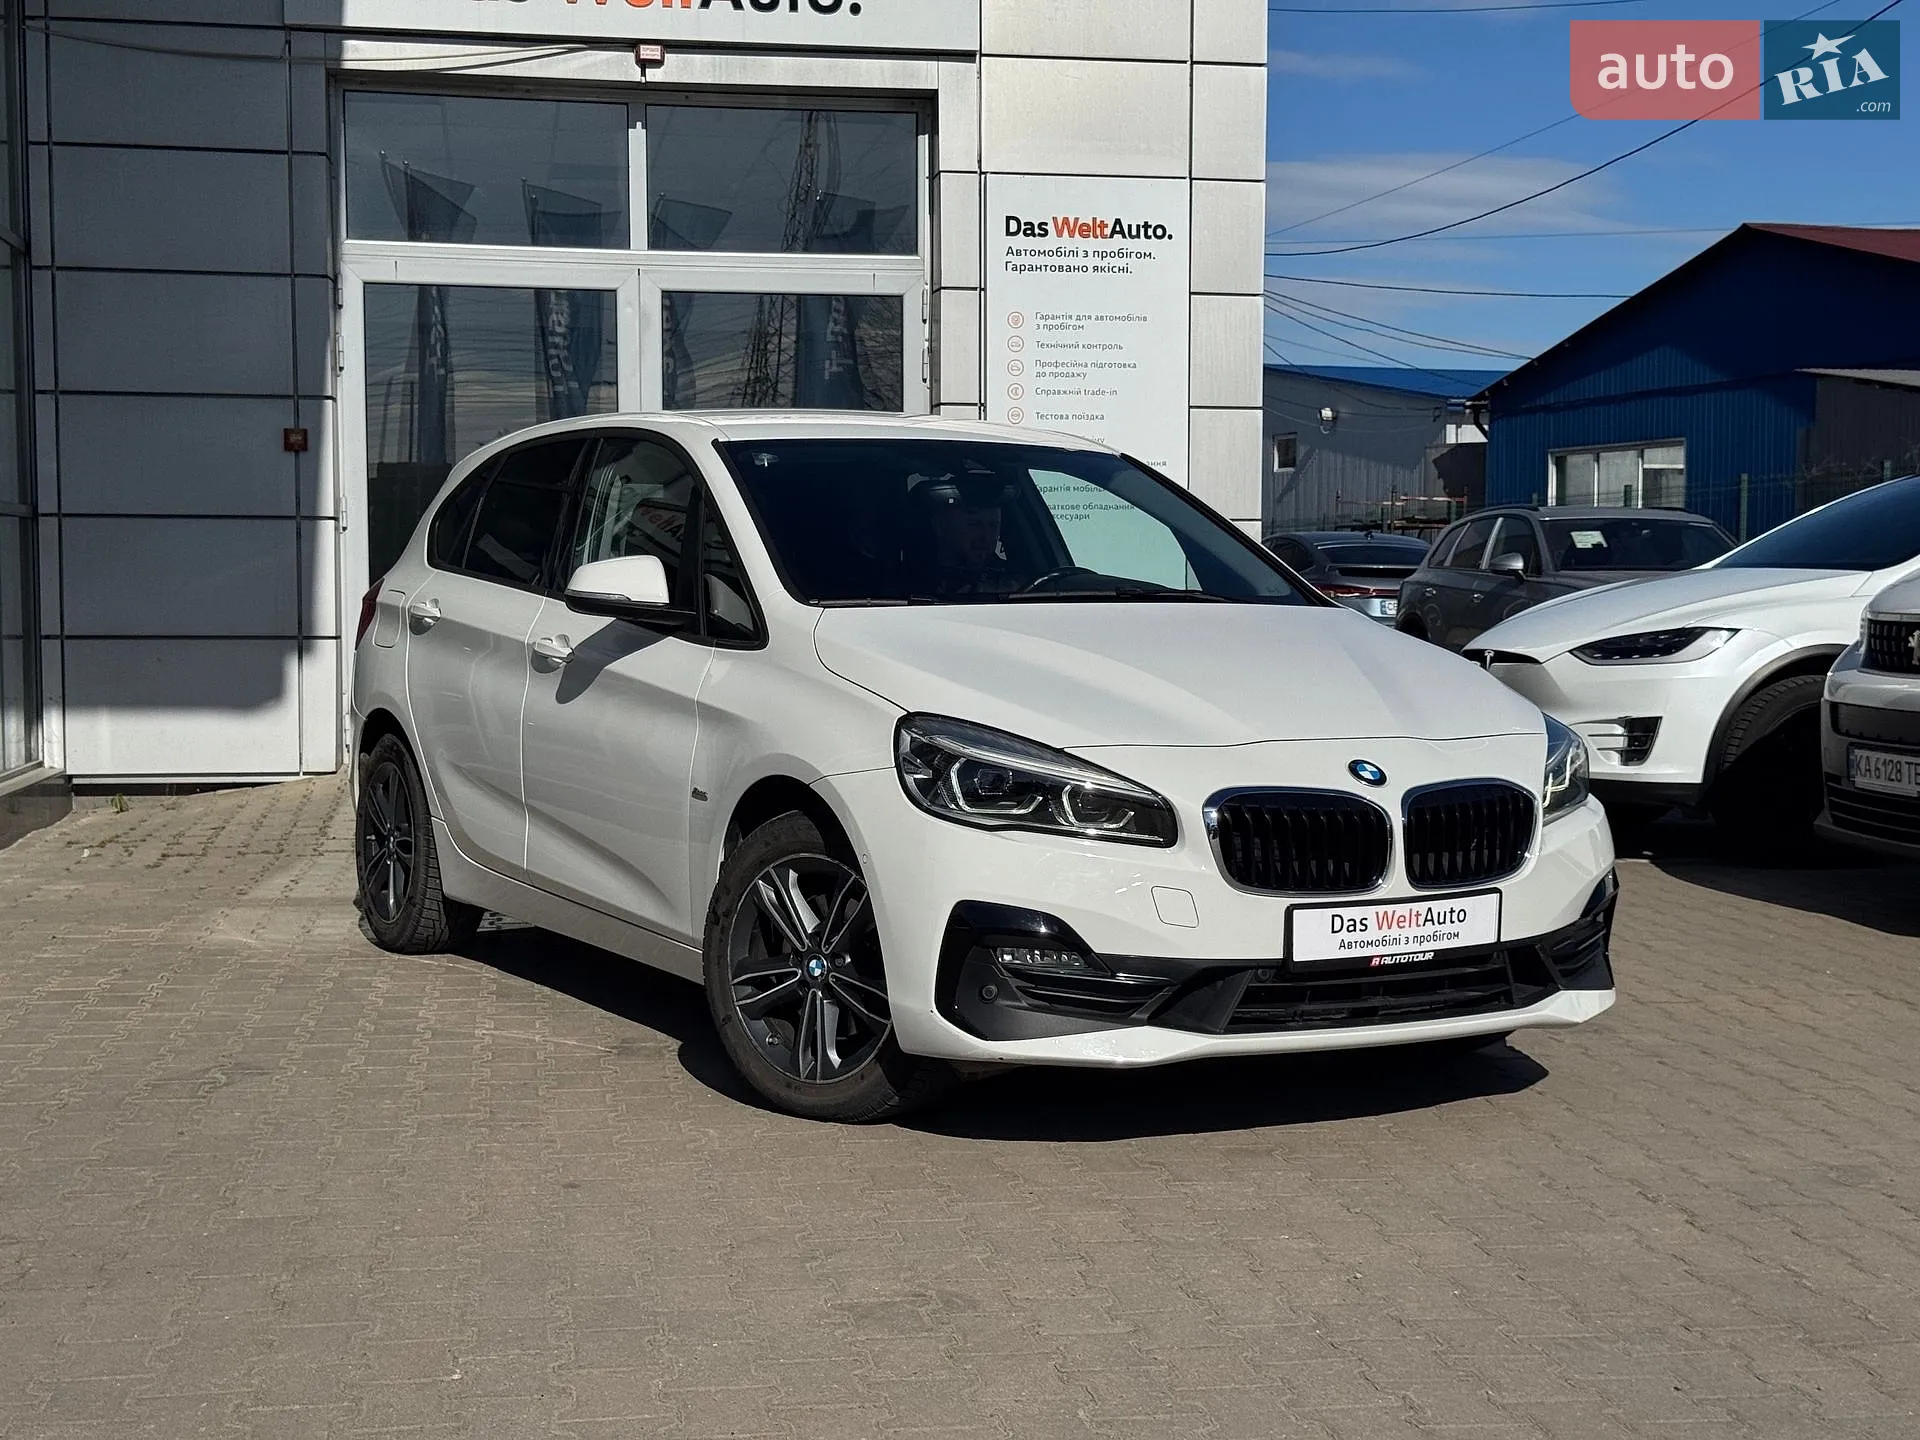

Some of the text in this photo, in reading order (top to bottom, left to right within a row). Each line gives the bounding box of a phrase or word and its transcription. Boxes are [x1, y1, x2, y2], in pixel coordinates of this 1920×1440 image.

[1005, 215, 1173, 241] Das WeltAuto.
[1005, 246, 1156, 261] Автомобілі з пробігом.
[1005, 261, 1133, 275] Гарантовано якісні.
[1035, 312, 1148, 323] Гарантія для автомобілів
[1035, 322, 1085, 332] з пробігом
[1035, 340, 1124, 351] Технічний контроль
[1035, 359, 1137, 369] Професійна підготовка
[1035, 371, 1088, 380] до продажу
[1035, 387, 1118, 397] Справжній trade-in
[1035, 411, 1105, 421] Тестова поїздка
[1037, 484, 1071, 494] арантія
[1855, 754, 1872, 779] KA
[1874, 757, 1902, 783] 6128
[1331, 907, 1467, 935] Das WeltAuto
[1338, 930, 1460, 951] Автомобілі з пробігом
[1380, 952, 1435, 965] AUTOTOUR
